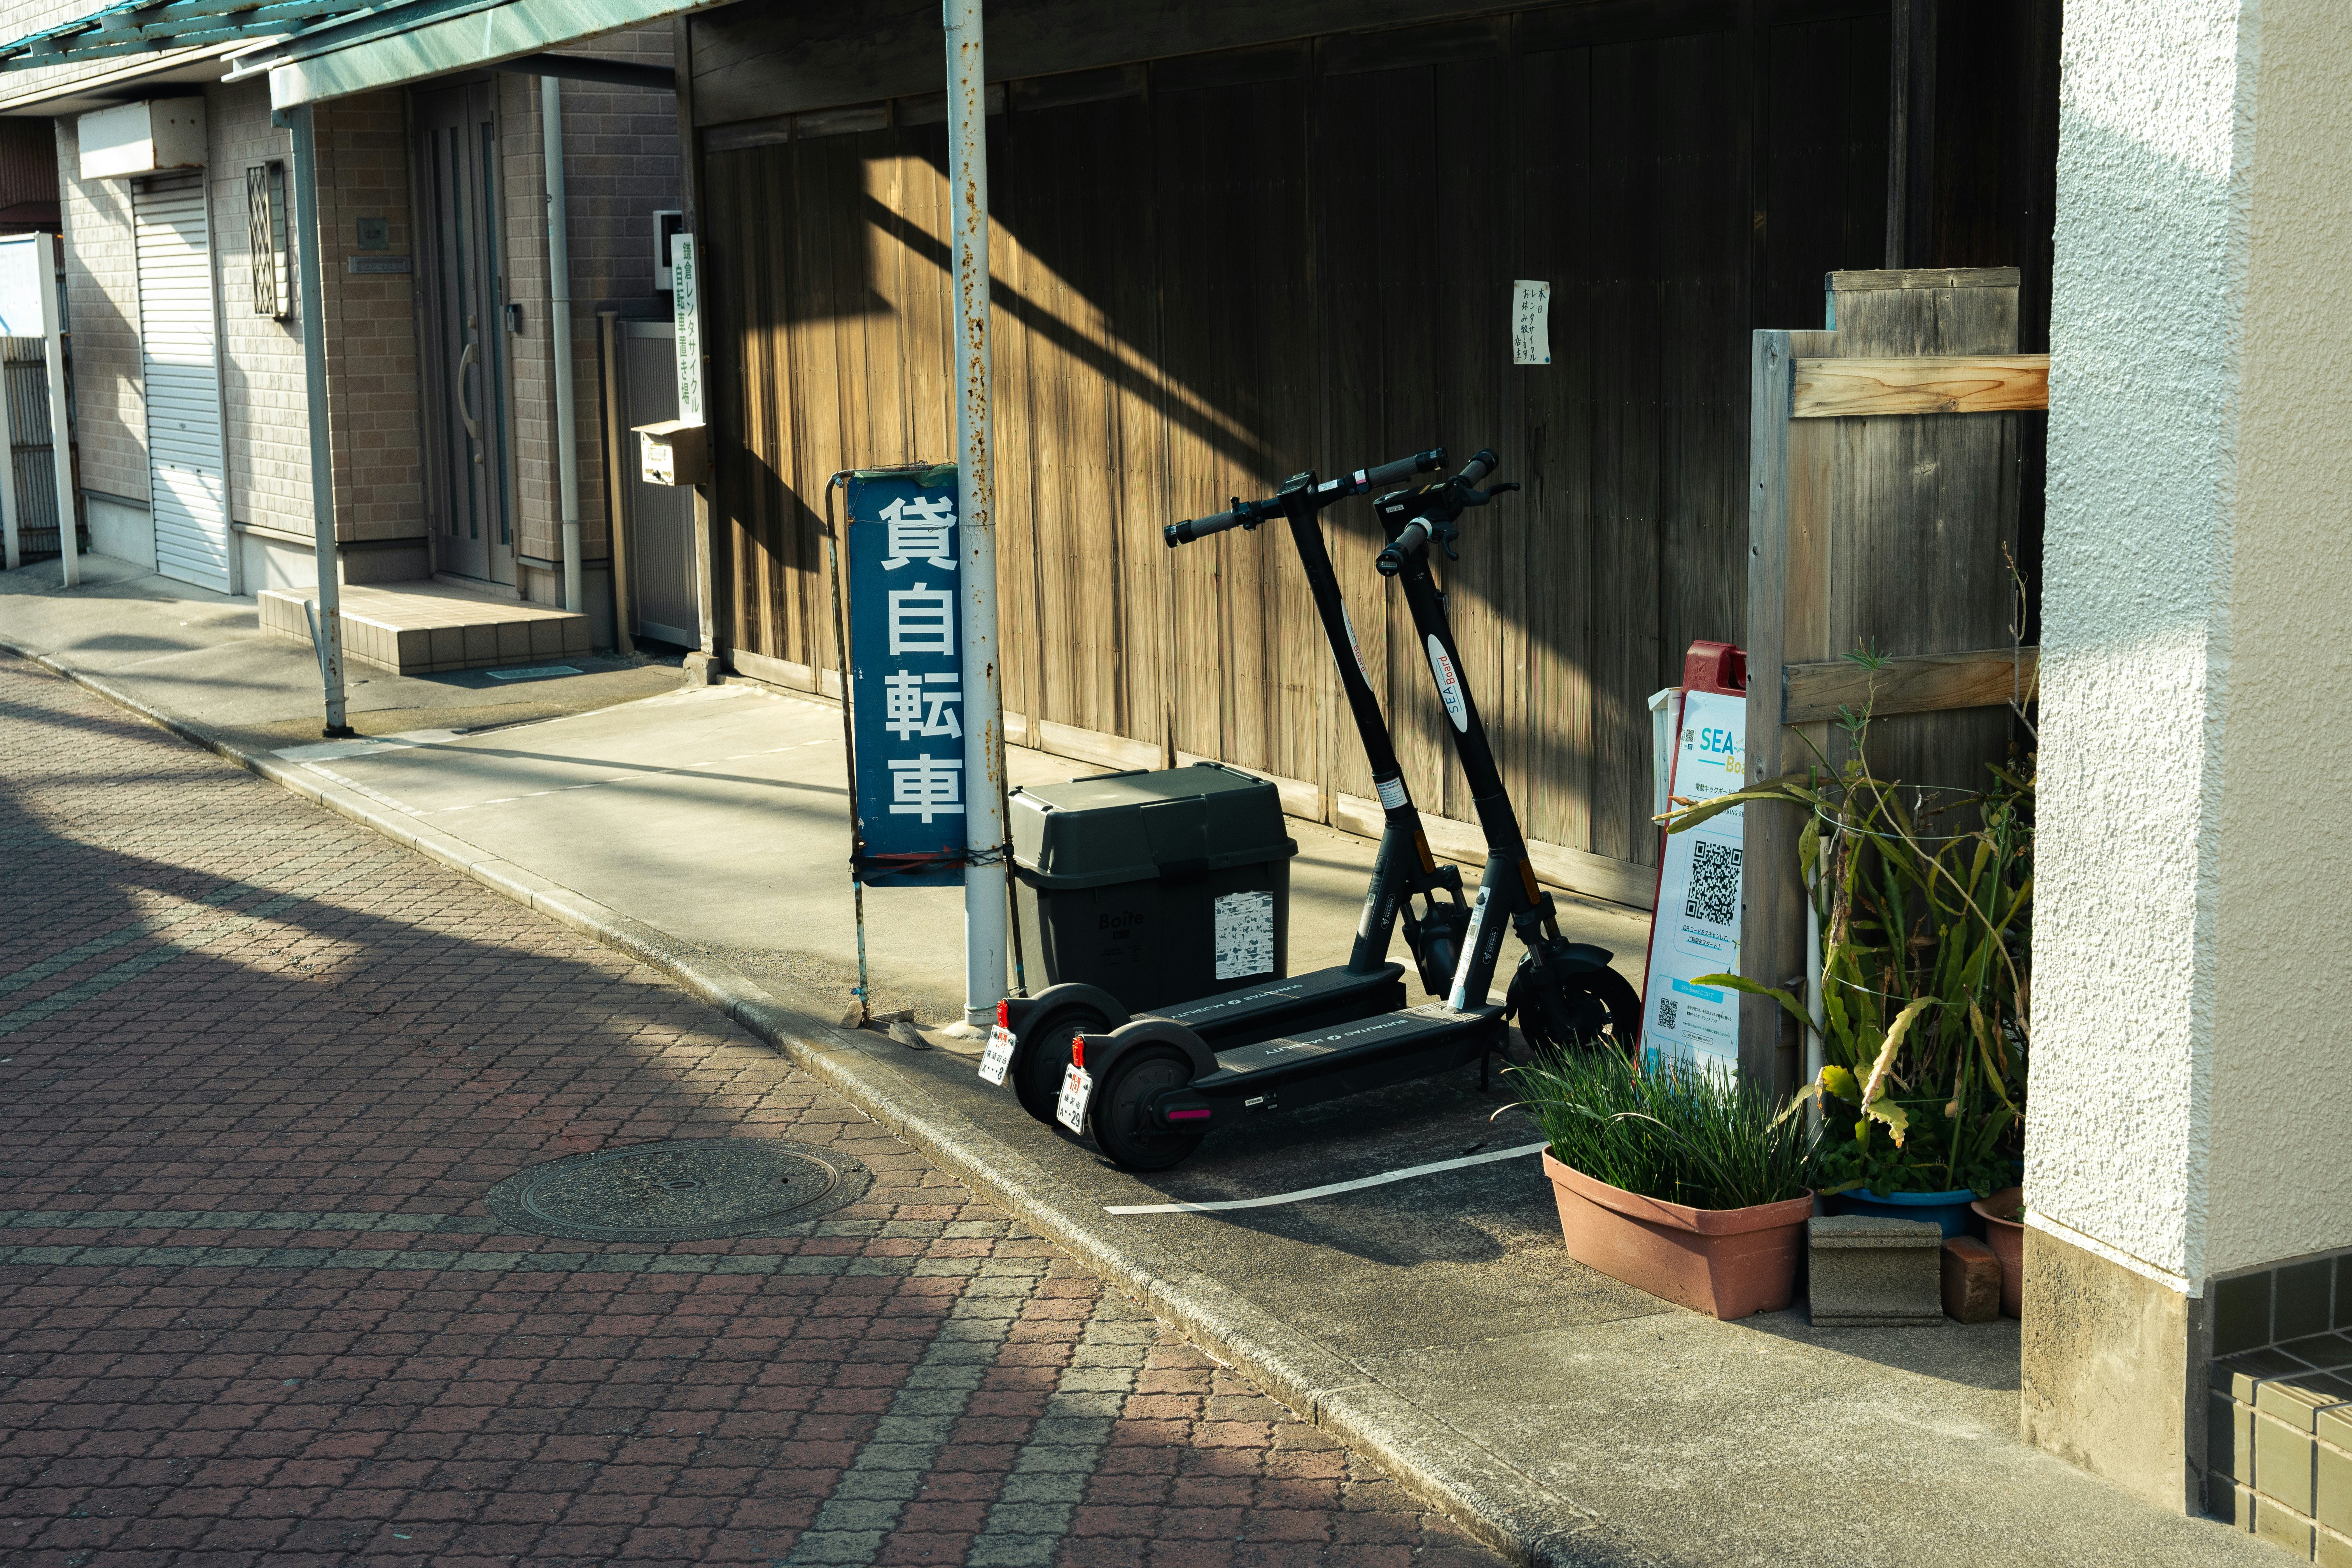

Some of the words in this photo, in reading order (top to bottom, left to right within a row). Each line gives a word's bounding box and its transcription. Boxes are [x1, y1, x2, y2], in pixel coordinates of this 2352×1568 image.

[1538, 287, 1546, 313] 本日
[676, 264, 689, 405] 自転車置き場
[683, 242, 699, 413] 鎌倉レンタサイクル
[1521, 289, 1529, 360] お休み致します
[1528, 289, 1537, 361] レンタサイクル
[1514, 335, 1522, 358] 店主
[878, 495, 964, 824] 貸自転車
[1438, 655, 1455, 685] Board
[1443, 686, 1458, 713] SEA
[1700, 728, 1733, 754] SEA
[1489, 931, 1497, 953] SEGWAY
[1244, 984, 1303, 1000] SUNAUTAS
[1345, 1019, 1409, 1036] SUNAUTAS
